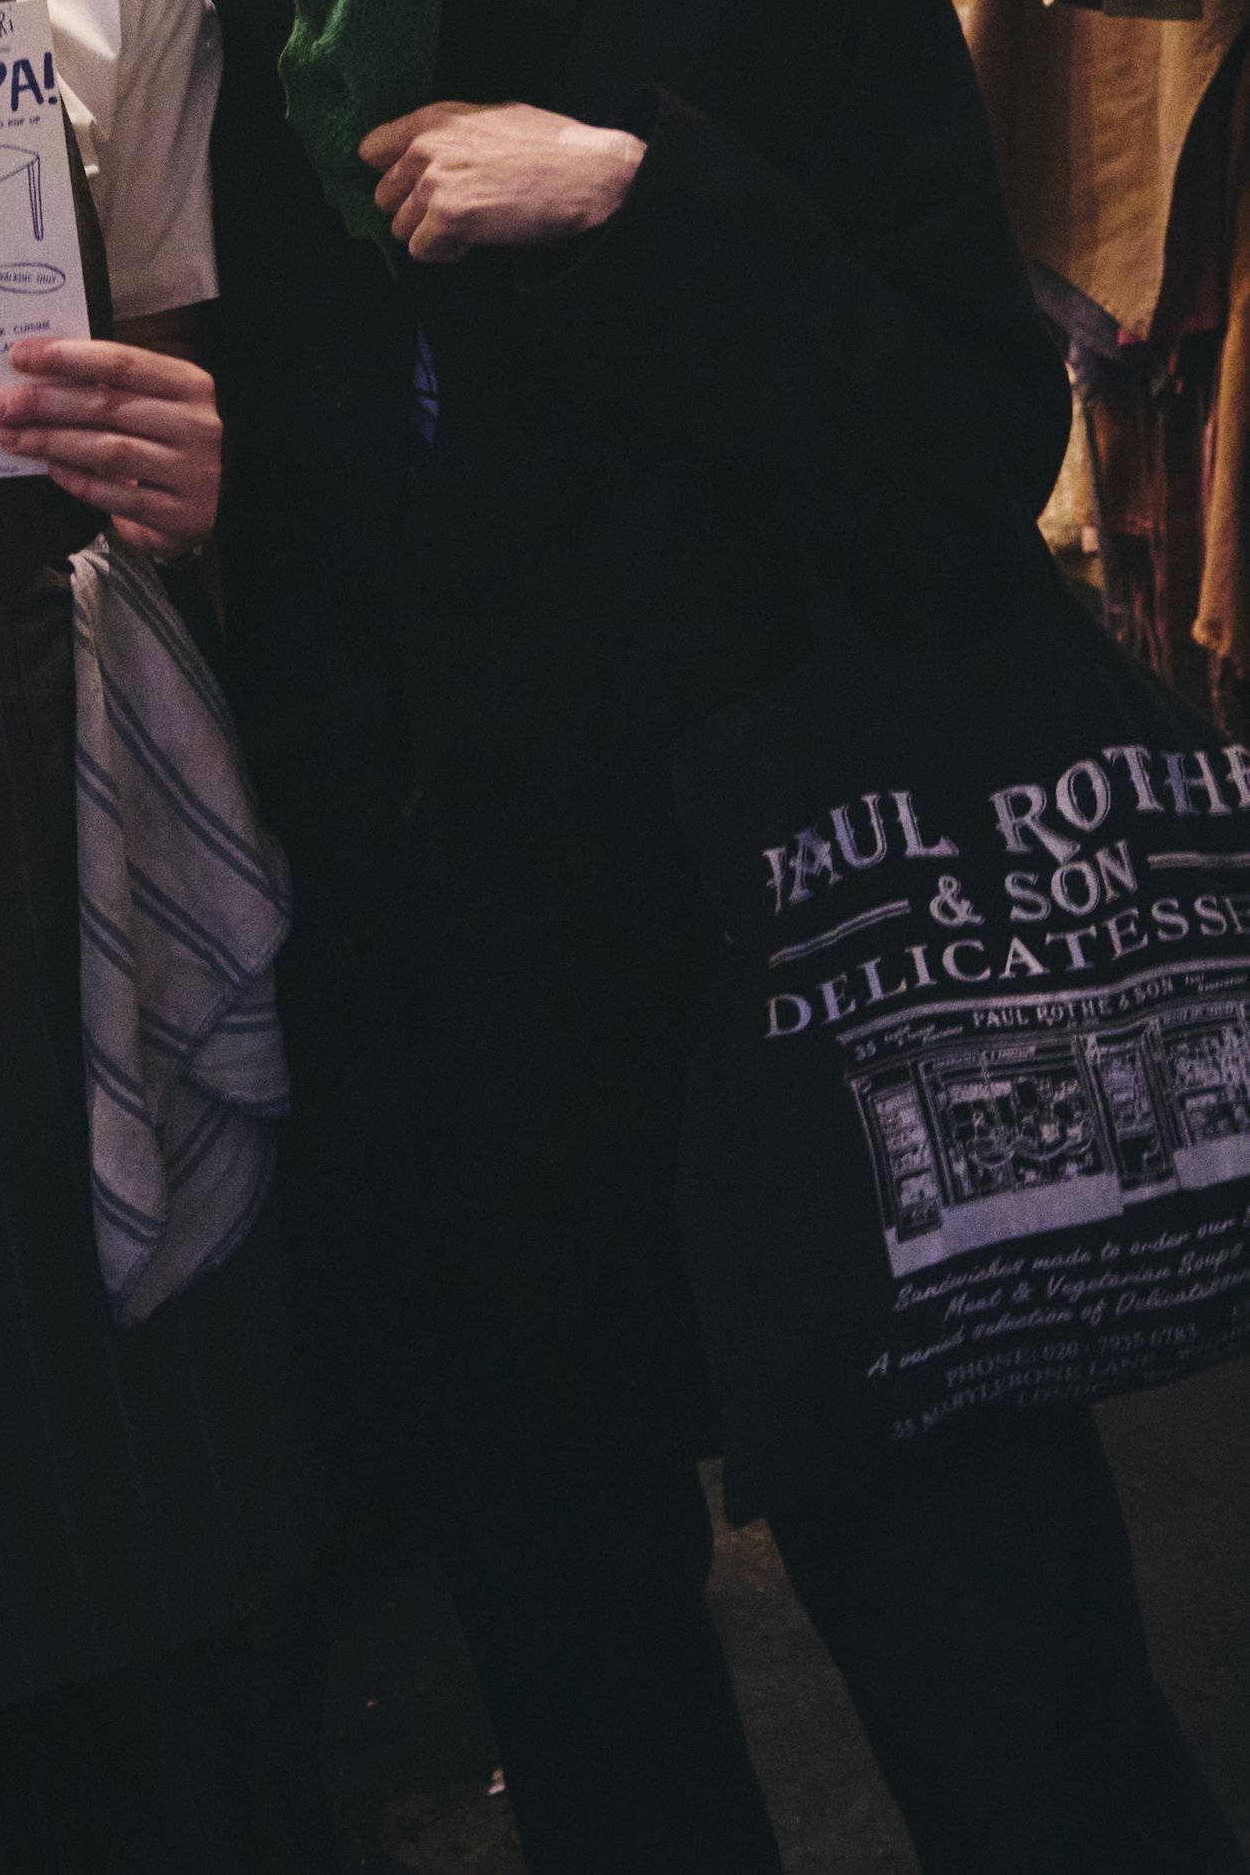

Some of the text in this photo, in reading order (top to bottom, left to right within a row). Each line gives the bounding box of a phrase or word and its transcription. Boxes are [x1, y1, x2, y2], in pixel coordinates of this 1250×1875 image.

[8, 118, 25, 128] POP
[29, 115, 41, 125] UP
[929, 841, 1138, 926] & SON
[973, 1002, 1031, 1030] PAUL
[1134, 977, 1174, 1008] SON
[895, 1255, 1029, 1312] Sandwiches
[1033, 1241, 1095, 1271] made
[1100, 1234, 1122, 1261] to
[1129, 1225, 1191, 1256] order
[1197, 1215, 1236, 1238] our
[944, 1240, 1243, 1323] Meat & Vegetarian Soups
[866, 1351, 891, 1381] A
[898, 1331, 967, 1369] varied
[974, 1305, 1077, 1346] selection
[1080, 1298, 1107, 1326] of
